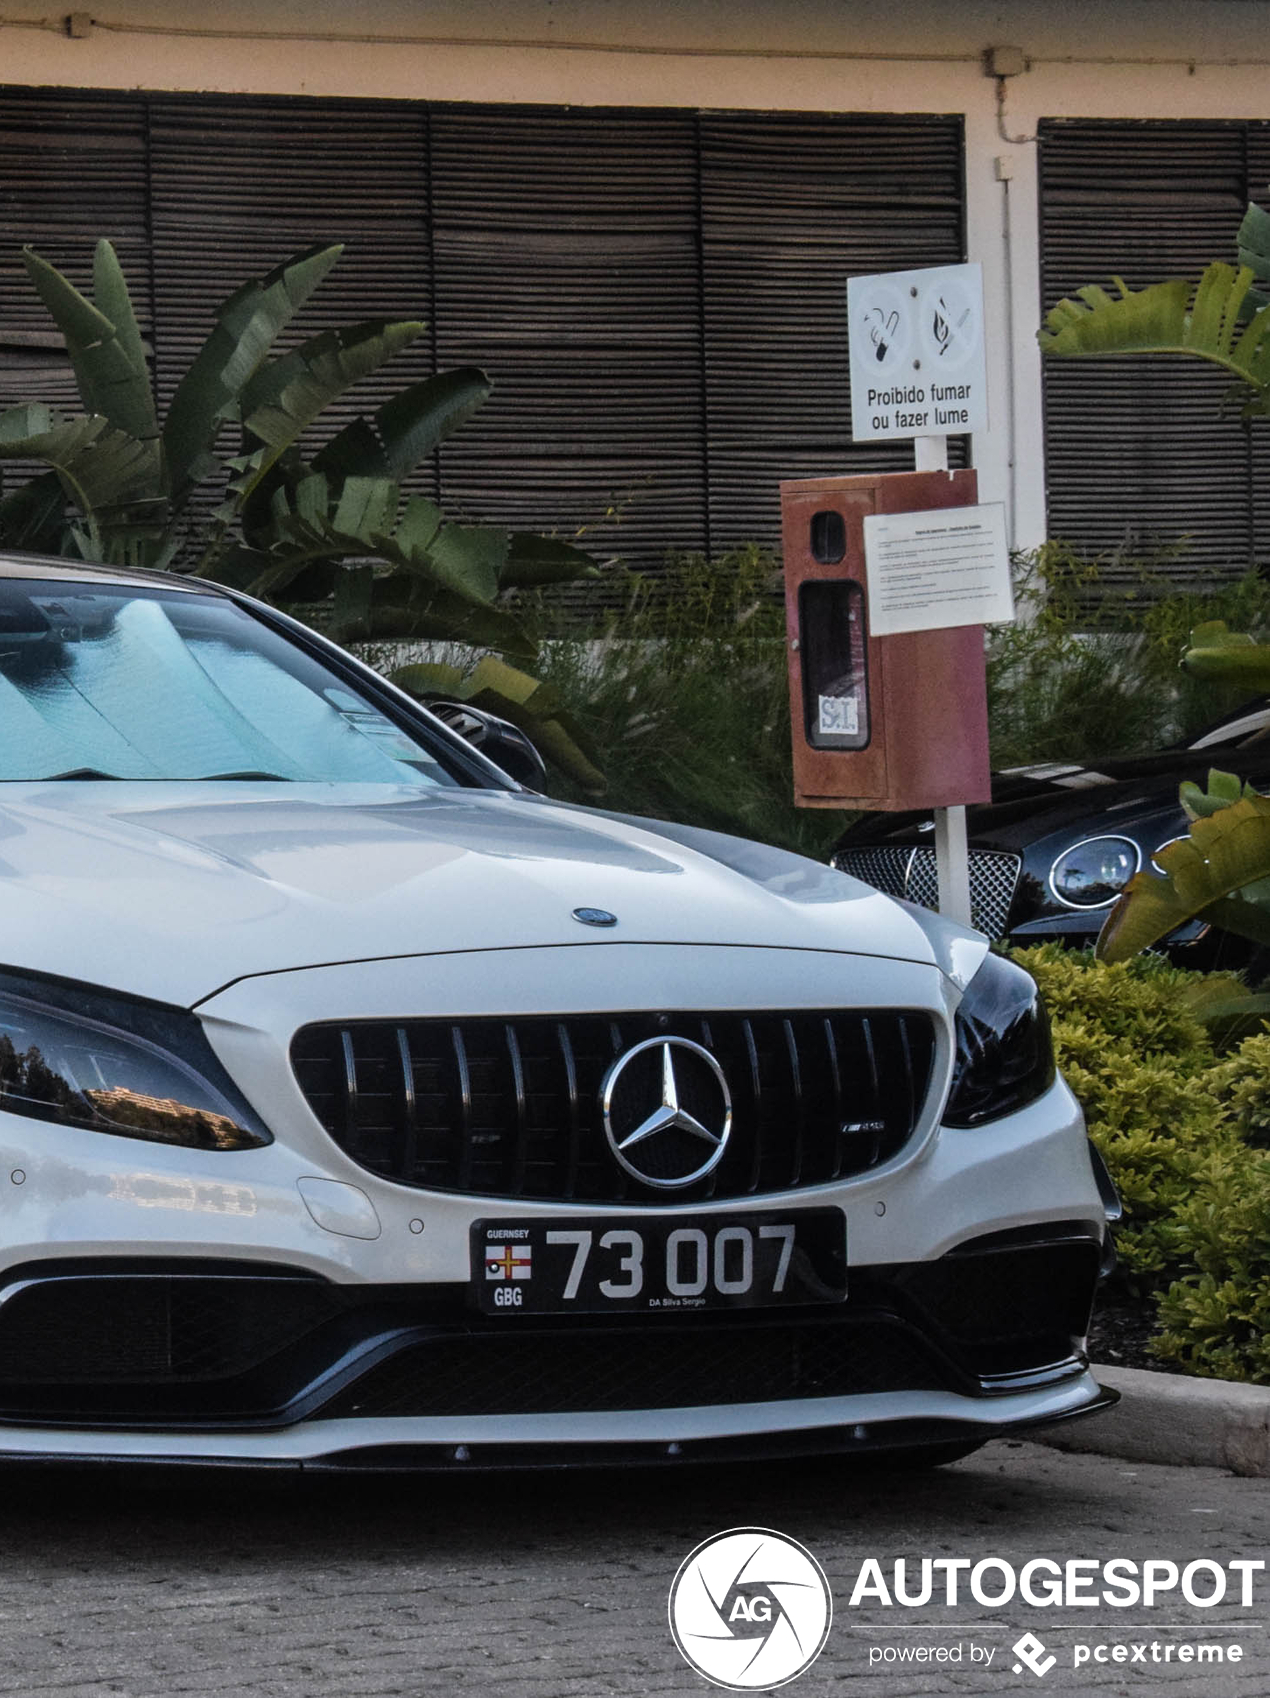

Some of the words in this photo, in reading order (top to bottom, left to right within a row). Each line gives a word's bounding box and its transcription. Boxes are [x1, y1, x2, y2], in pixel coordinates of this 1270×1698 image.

[868, 386, 925, 406] Proibido
[931, 383, 971, 402] fumar
[872, 415, 889, 429] ou
[895, 410, 928, 428] fazer
[935, 408, 969, 425] lume
[487, 1229, 530, 1239] GUERNSEY
[546, 1230, 644, 1299] 73
[666, 1225, 795, 1297] 007
[494, 1287, 523, 1306] GBG
[662, 1298, 681, 1307] Silva
[682, 1296, 706, 1308] Sergio
